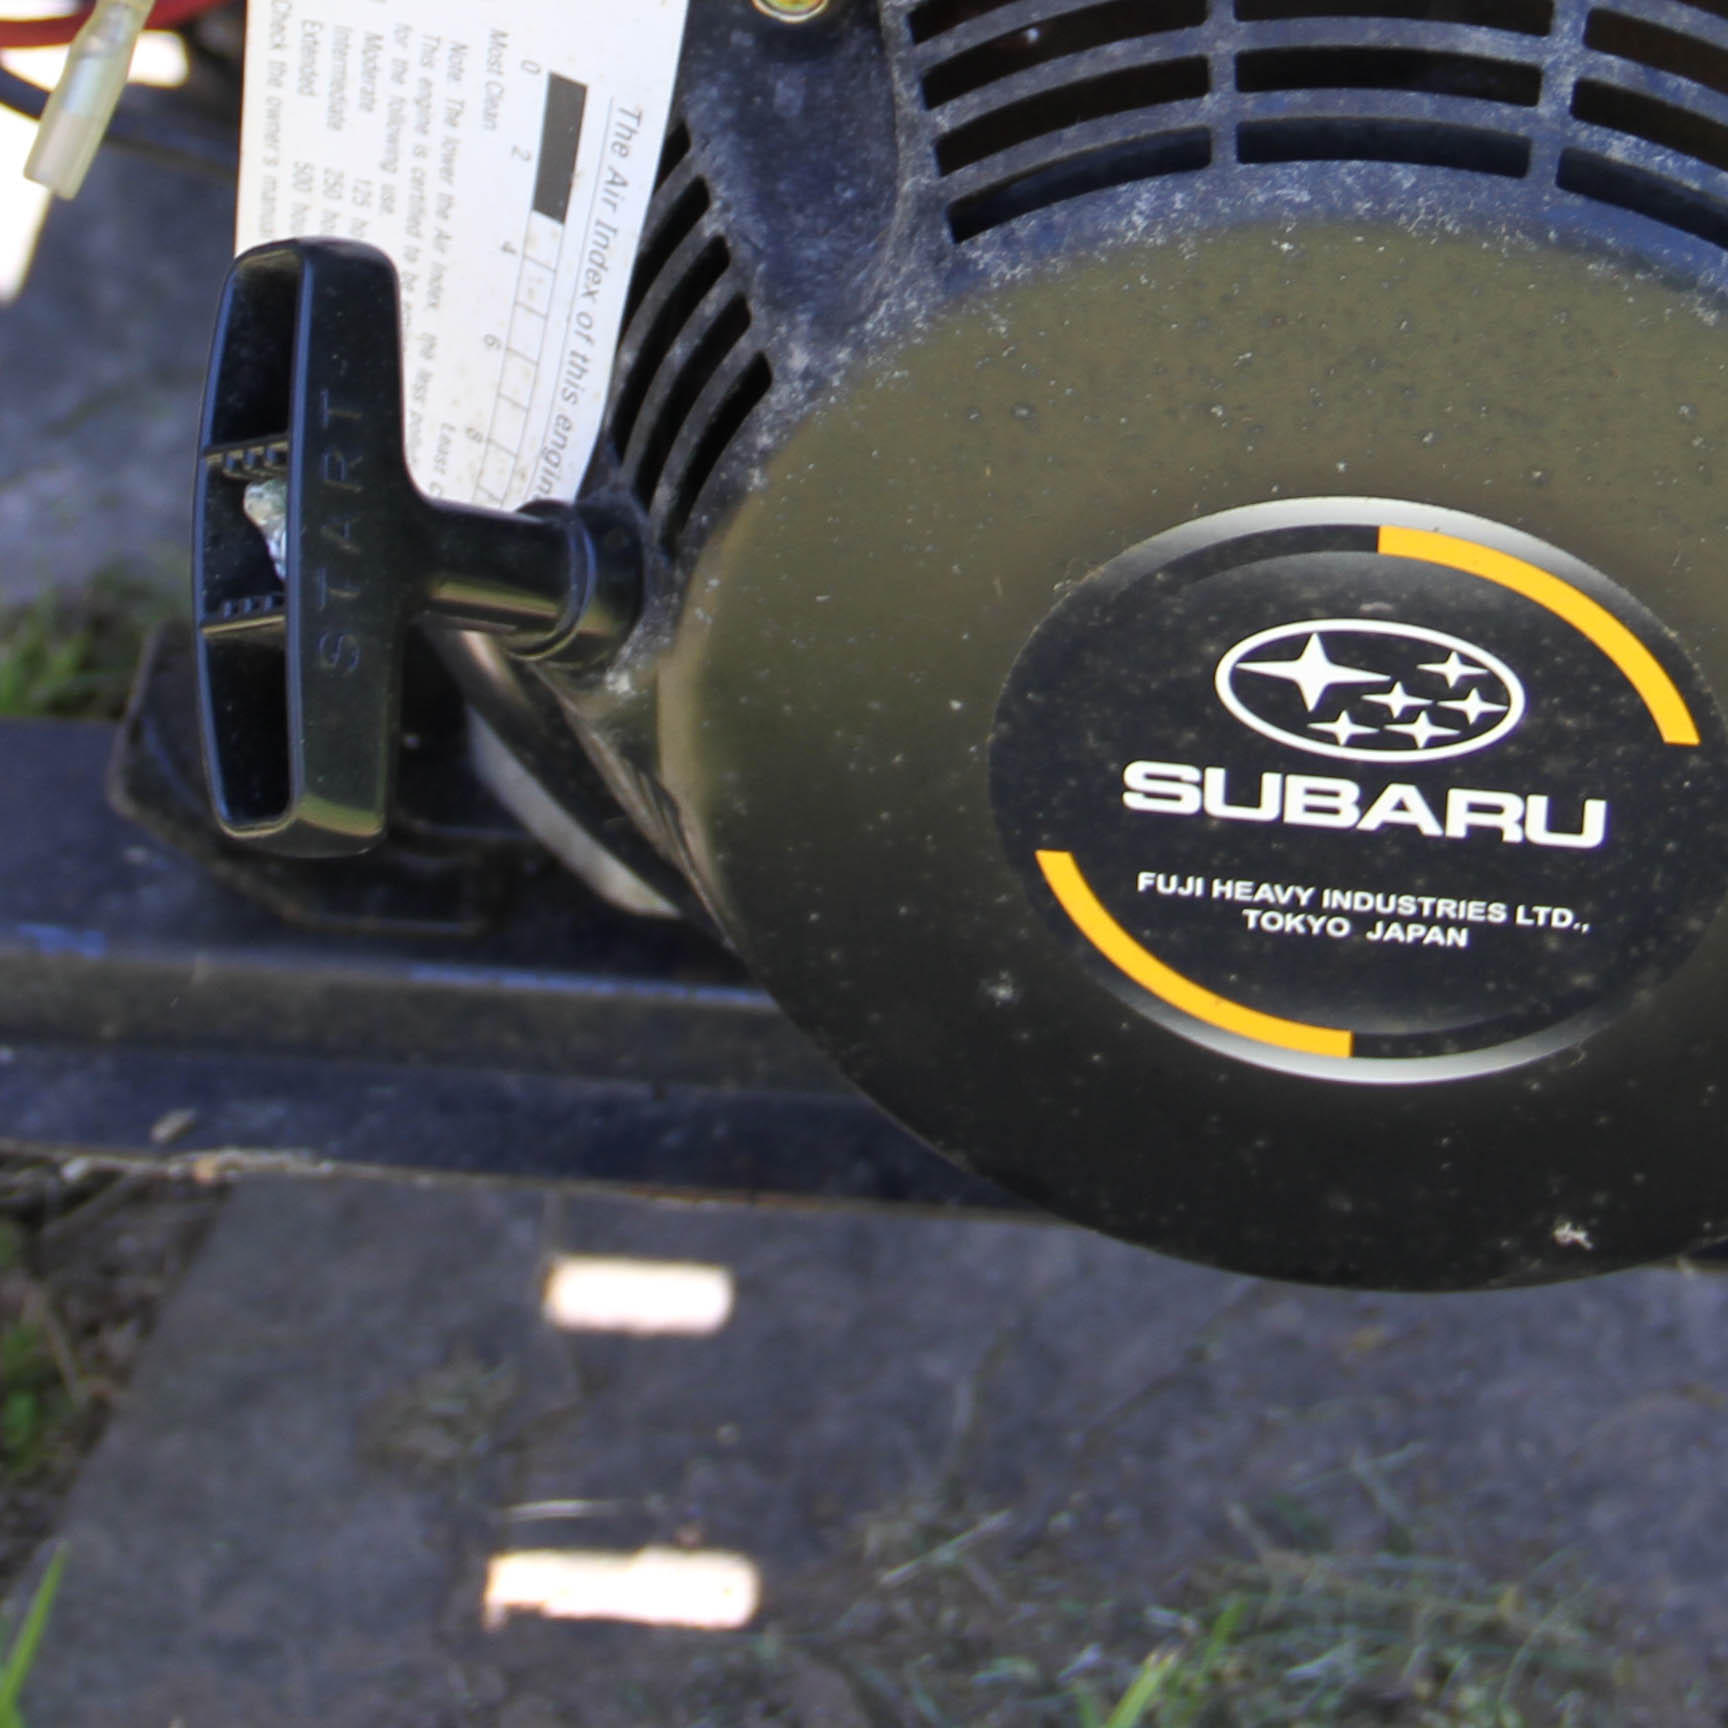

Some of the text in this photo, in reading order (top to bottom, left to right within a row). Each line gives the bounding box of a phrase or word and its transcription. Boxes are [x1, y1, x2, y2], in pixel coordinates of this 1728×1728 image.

[268, 59, 287, 88] the
[297, 20, 323, 97] Extended
[359, 32, 384, 113] Moderate
[390, 57, 409, 85] the
[420, 34, 441, 69] This
[521, 59, 541, 76] 0
[327, 25, 353, 132] Intermediate
[482, 28, 509, 131] Most Clean
[414, 77, 433, 136] engine
[444, 97, 465, 128] The
[512, 145, 531, 162] 2
[611, 106, 643, 158] The
[439, 136, 459, 186] lower
[434, 192, 455, 221] the
[601, 168, 629, 212] Air
[433, 226, 453, 254] Air
[501, 240, 517, 256] 4
[581, 220, 618, 304] Index
[483, 333, 502, 350] 6
[573, 311, 595, 347] of
[561, 351, 591, 406] this
[318, 386, 364, 678] START
[1122, 759, 1608, 849] SUBARU
[1137, 870, 1205, 900] FUJI
[1211, 877, 1316, 910] HEAVY
[1320, 886, 1508, 926] INDUSTRIES
[1242, 908, 1469, 949] TOKYO JAPAN
